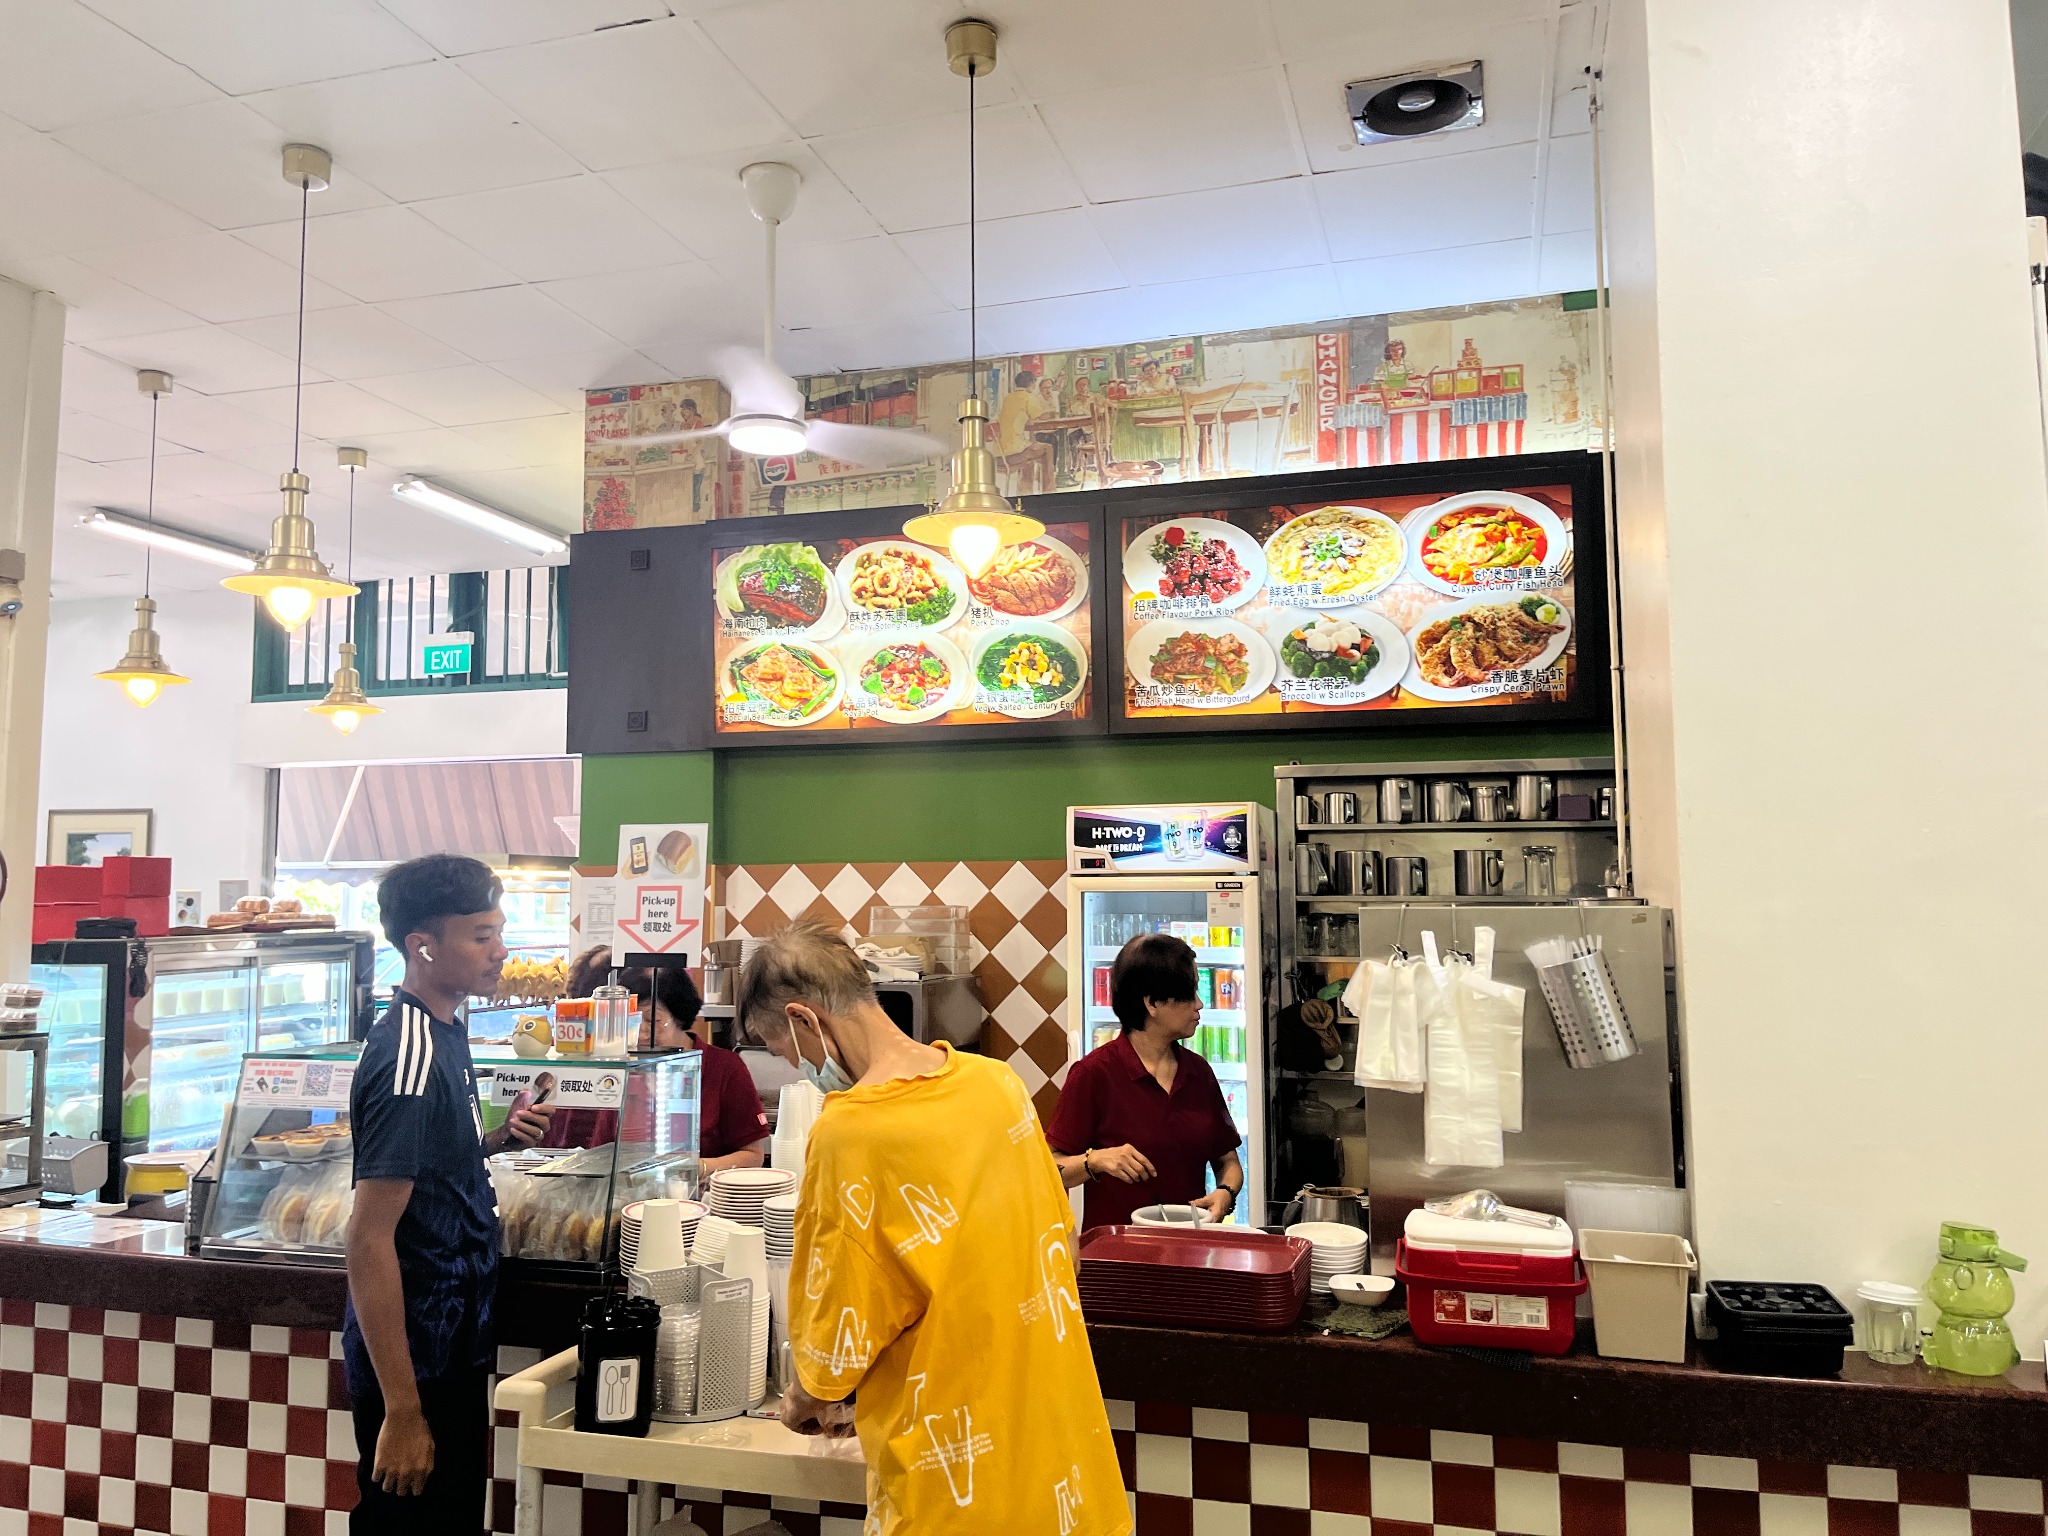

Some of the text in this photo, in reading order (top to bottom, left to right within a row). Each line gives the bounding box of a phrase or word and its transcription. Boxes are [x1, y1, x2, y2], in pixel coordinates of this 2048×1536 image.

[1318, 333, 1337, 431] CHANGER
[765, 463, 787, 474] PEPSI
[1451, 579, 1564, 594] Claypot Curry Fish Head
[1133, 595, 1211, 612] 招牌咖啡排骨
[1269, 598, 1289, 607] Fried
[1292, 597, 1310, 609] Egg
[1321, 595, 1347, 604] Fresh
[1348, 593, 1379, 605] Oyster
[970, 606, 994, 619] 猪扒
[1133, 607, 1235, 620] Coffee Flavour Pork Ribs
[849, 620, 920, 632] Crispy Sotong Ring
[970, 618, 1010, 627] Pork Chop
[722, 629, 759, 638] Hainanese
[431, 649, 462, 671] EXIT
[1490, 667, 1564, 683] 香脆麦片虾
[1135, 685, 1200, 699] 苦瓜炒鱼头
[1281, 691, 1317, 701] Broccoli
[1328, 689, 1366, 701] Scallops
[1471, 682, 1565, 695] Crispy Cereal Prawn
[974, 703, 989, 713] Veg
[998, 703, 1022, 711] Salted
[1028, 700, 1058, 711] Century
[1060, 700, 1075, 712] Egg
[1135, 697, 1156, 707] Fried
[1156, 696, 1173, 706] Fish
[1174, 696, 1195, 706] Head
[1205, 694, 1251, 705] Bittergourd
[724, 713, 751, 723] Special
[843, 709, 879, 718] Royal Pot
[642, 896, 676, 907] Pick-up
[647, 909, 669, 919] here
[642, 922, 672, 933] 领取处
[496, 1072, 531, 1085] Pick-up
[502, 1087, 521, 1097] her
[560, 1079, 594, 1093] 领取处
